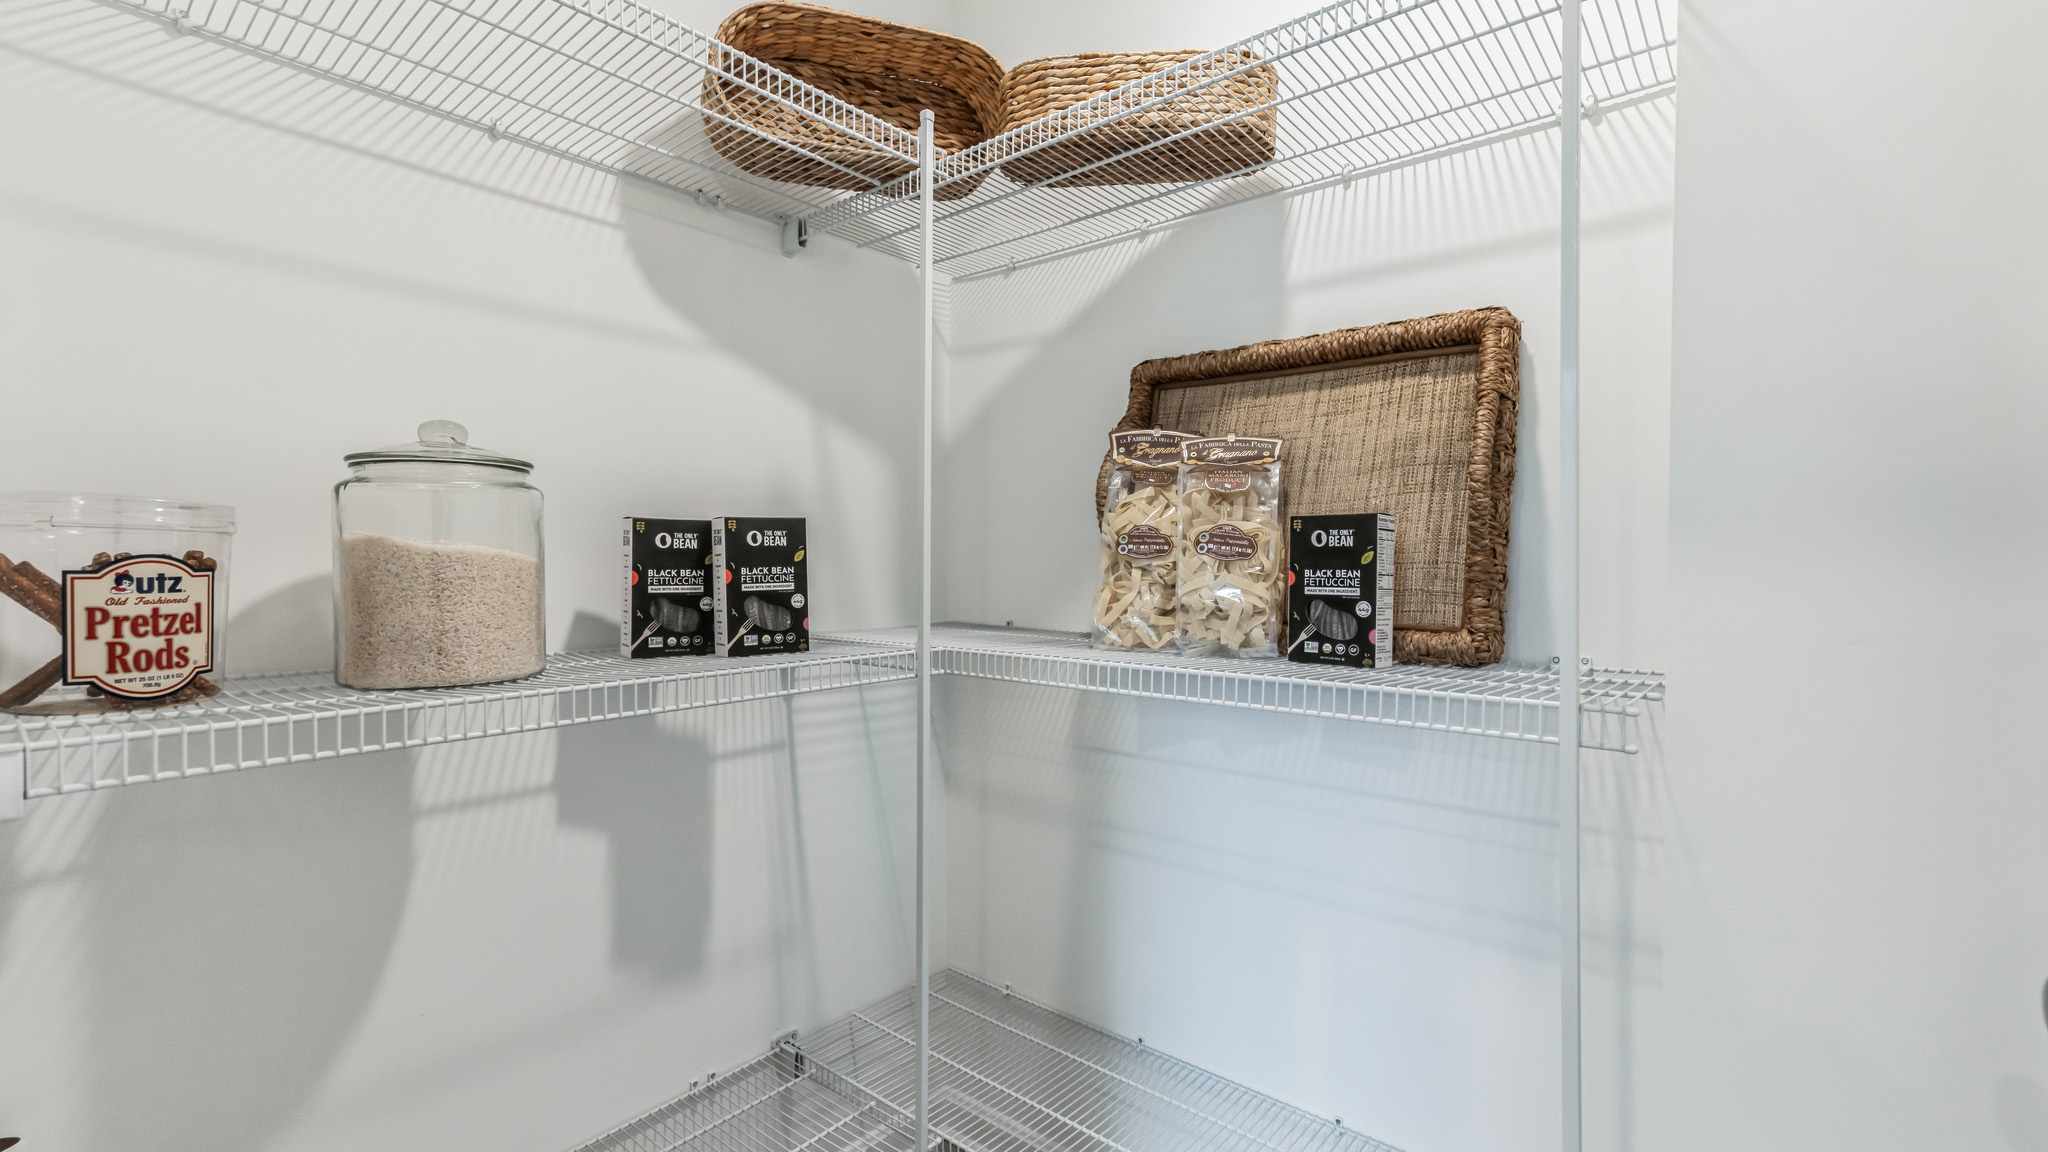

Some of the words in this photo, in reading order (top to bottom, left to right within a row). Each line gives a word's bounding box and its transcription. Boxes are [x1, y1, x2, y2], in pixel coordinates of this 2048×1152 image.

[1251, 441, 1272, 449] PASTA
[673, 539, 698, 549] BEAN
[764, 536, 787, 546] BEAN
[1329, 536, 1354, 547] BEAN
[648, 569, 677, 577] BLACK
[680, 569, 704, 577] BEAN
[741, 567, 769, 575] BLACK
[771, 566, 794, 574] BEAN
[648, 577, 704, 585] FETTUCCINE
[741, 574, 794, 583] FETTUCCINE
[1305, 578, 1360, 586] FETTUCCINE
[105, 597, 129, 606] Old
[134, 595, 190, 605] Fashioned
[84, 602, 202, 640] Pretzel
[105, 638, 190, 674] Rods
